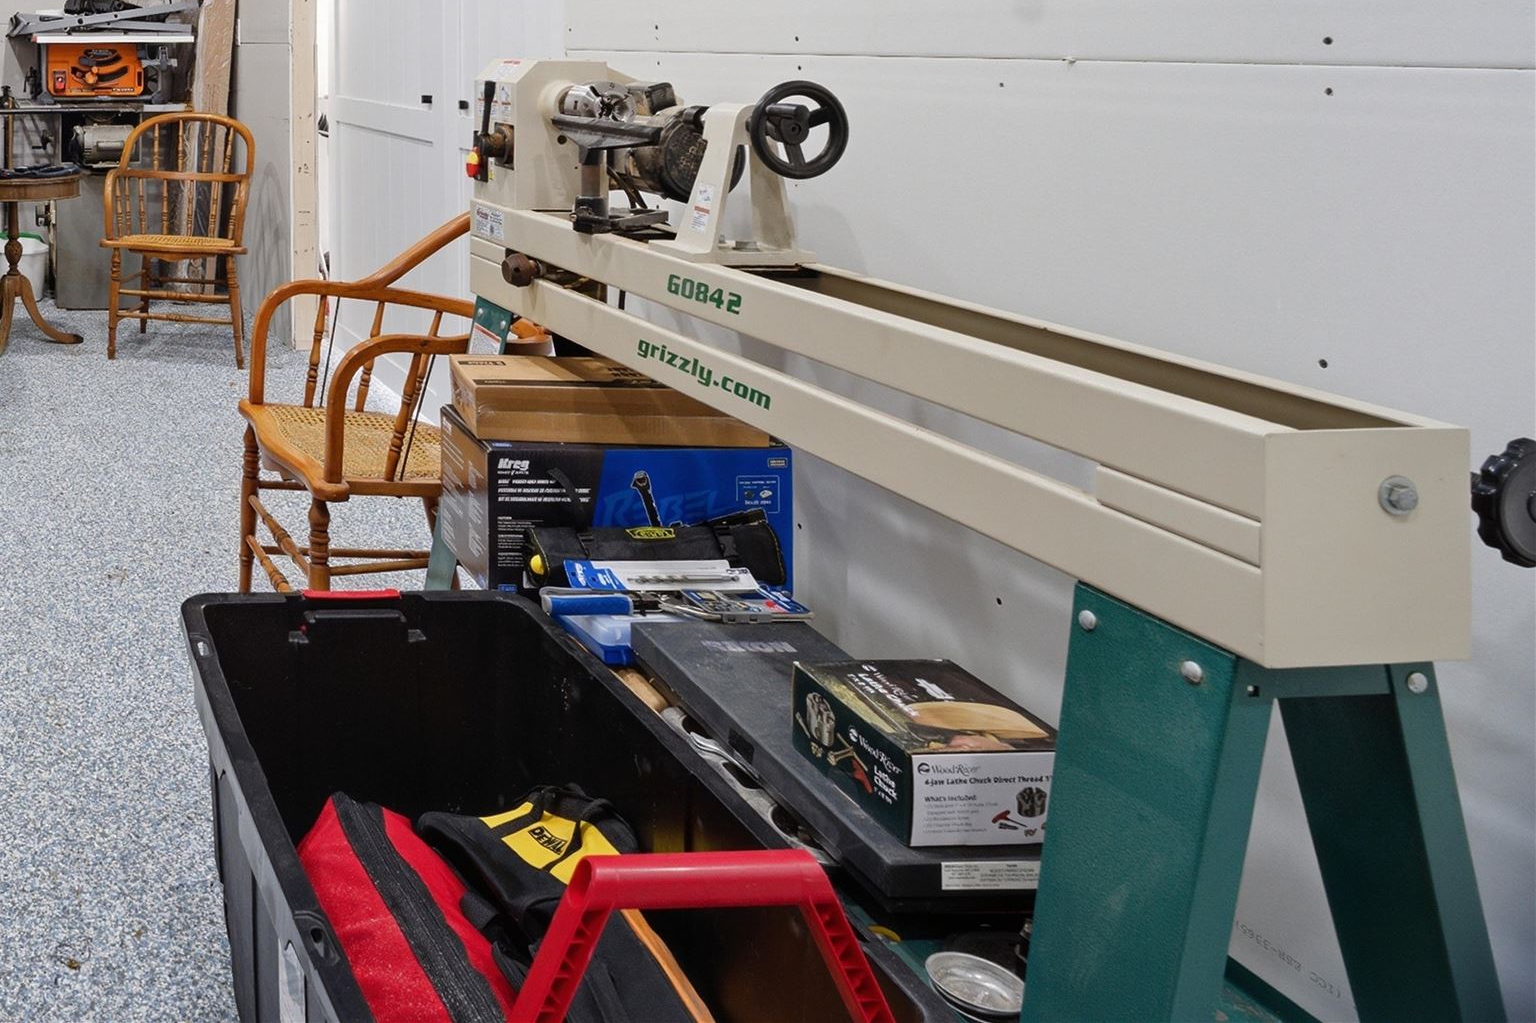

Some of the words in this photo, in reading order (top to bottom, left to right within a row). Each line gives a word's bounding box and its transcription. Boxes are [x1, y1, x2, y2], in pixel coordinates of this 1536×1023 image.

[667, 274, 742, 315] G0842
[637, 339, 772, 410] grizzly.com
[497, 458, 530, 471] Kreg
[946, 777, 968, 785] Lathe
[969, 776, 992, 784] Chuck
[994, 776, 1016, 784] Direct
[1018, 775, 1043, 783] Thread
[530, 826, 567, 855] DEWAL
